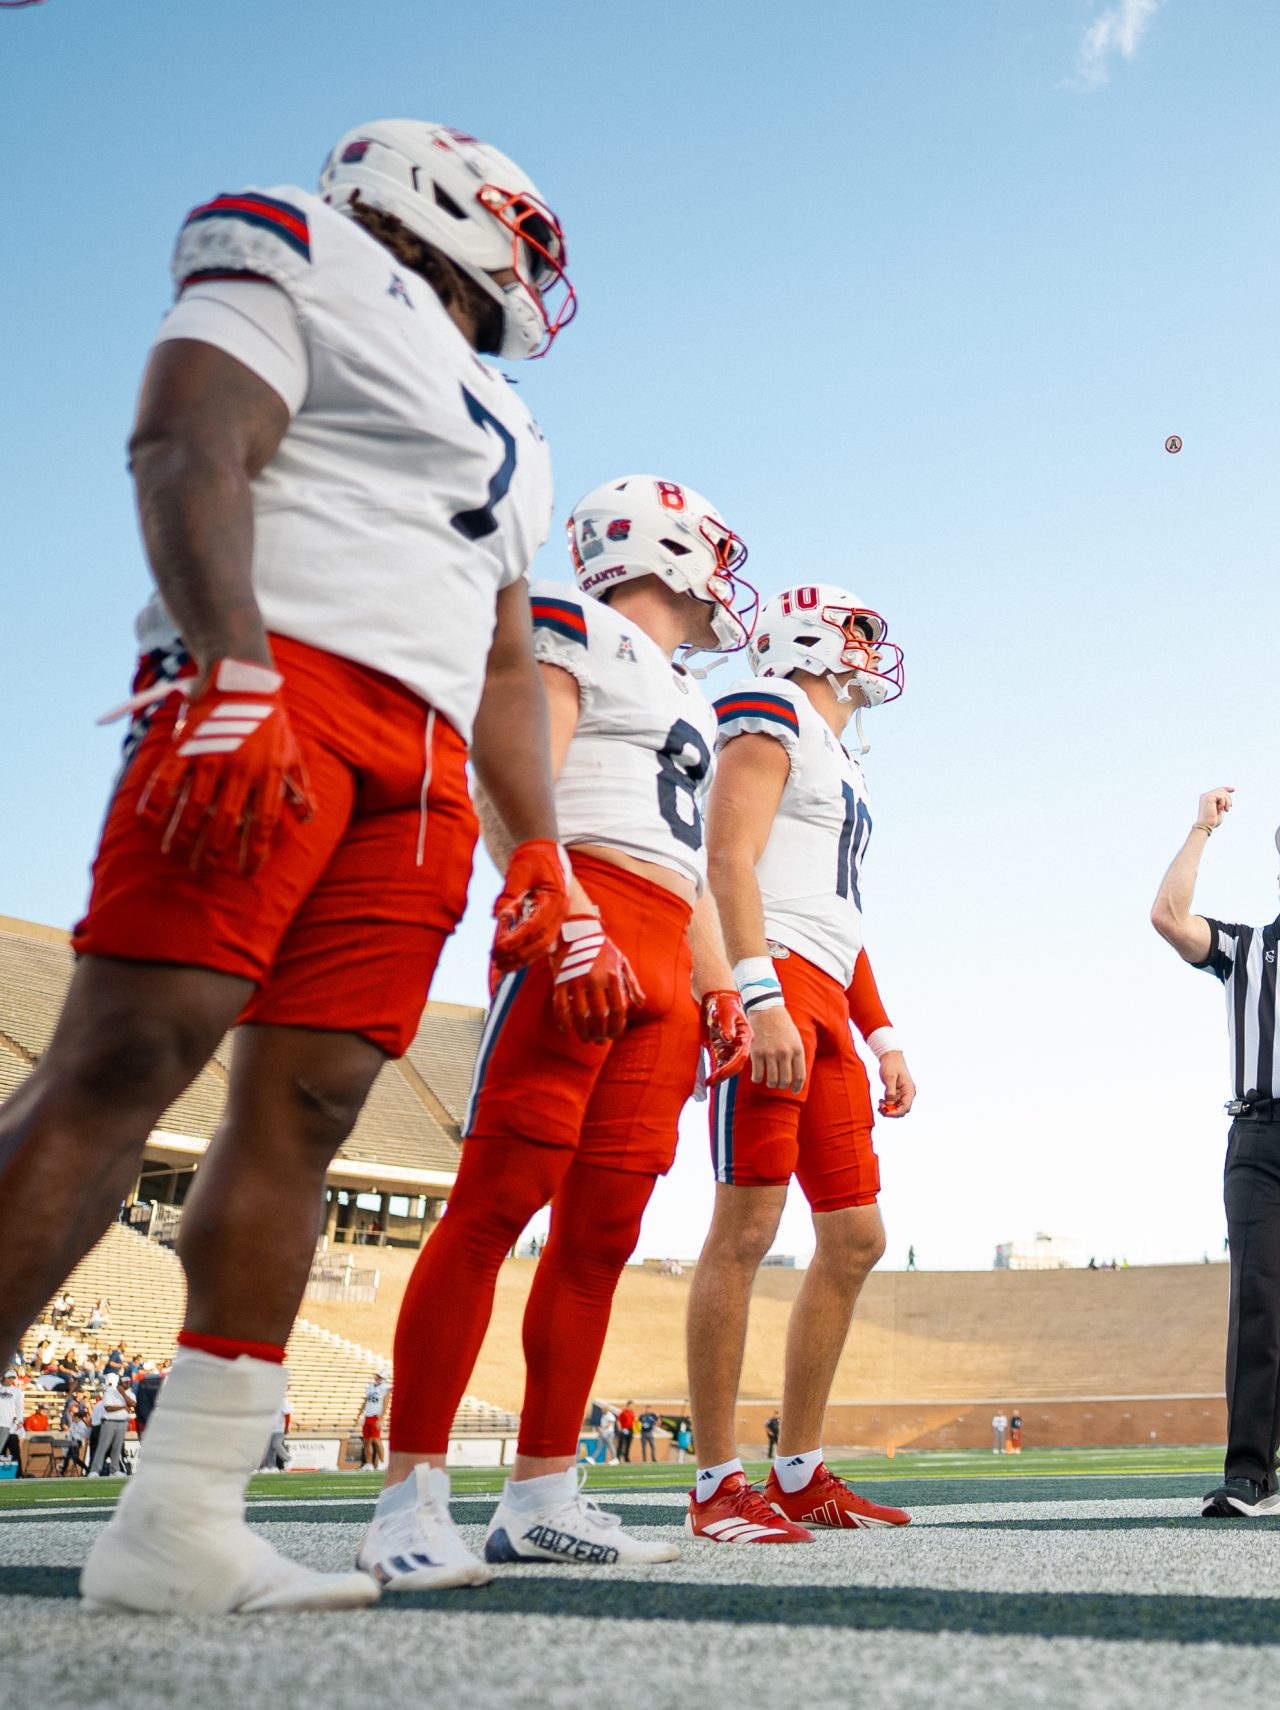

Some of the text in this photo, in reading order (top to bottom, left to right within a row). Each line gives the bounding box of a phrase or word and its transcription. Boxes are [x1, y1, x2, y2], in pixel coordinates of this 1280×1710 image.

[450, 380, 517, 540] 7
[656, 480, 687, 513] 8
[778, 586, 820, 617] 10
[656, 717, 711, 852] 8
[522, 1524, 620, 1565] ADIZERO
